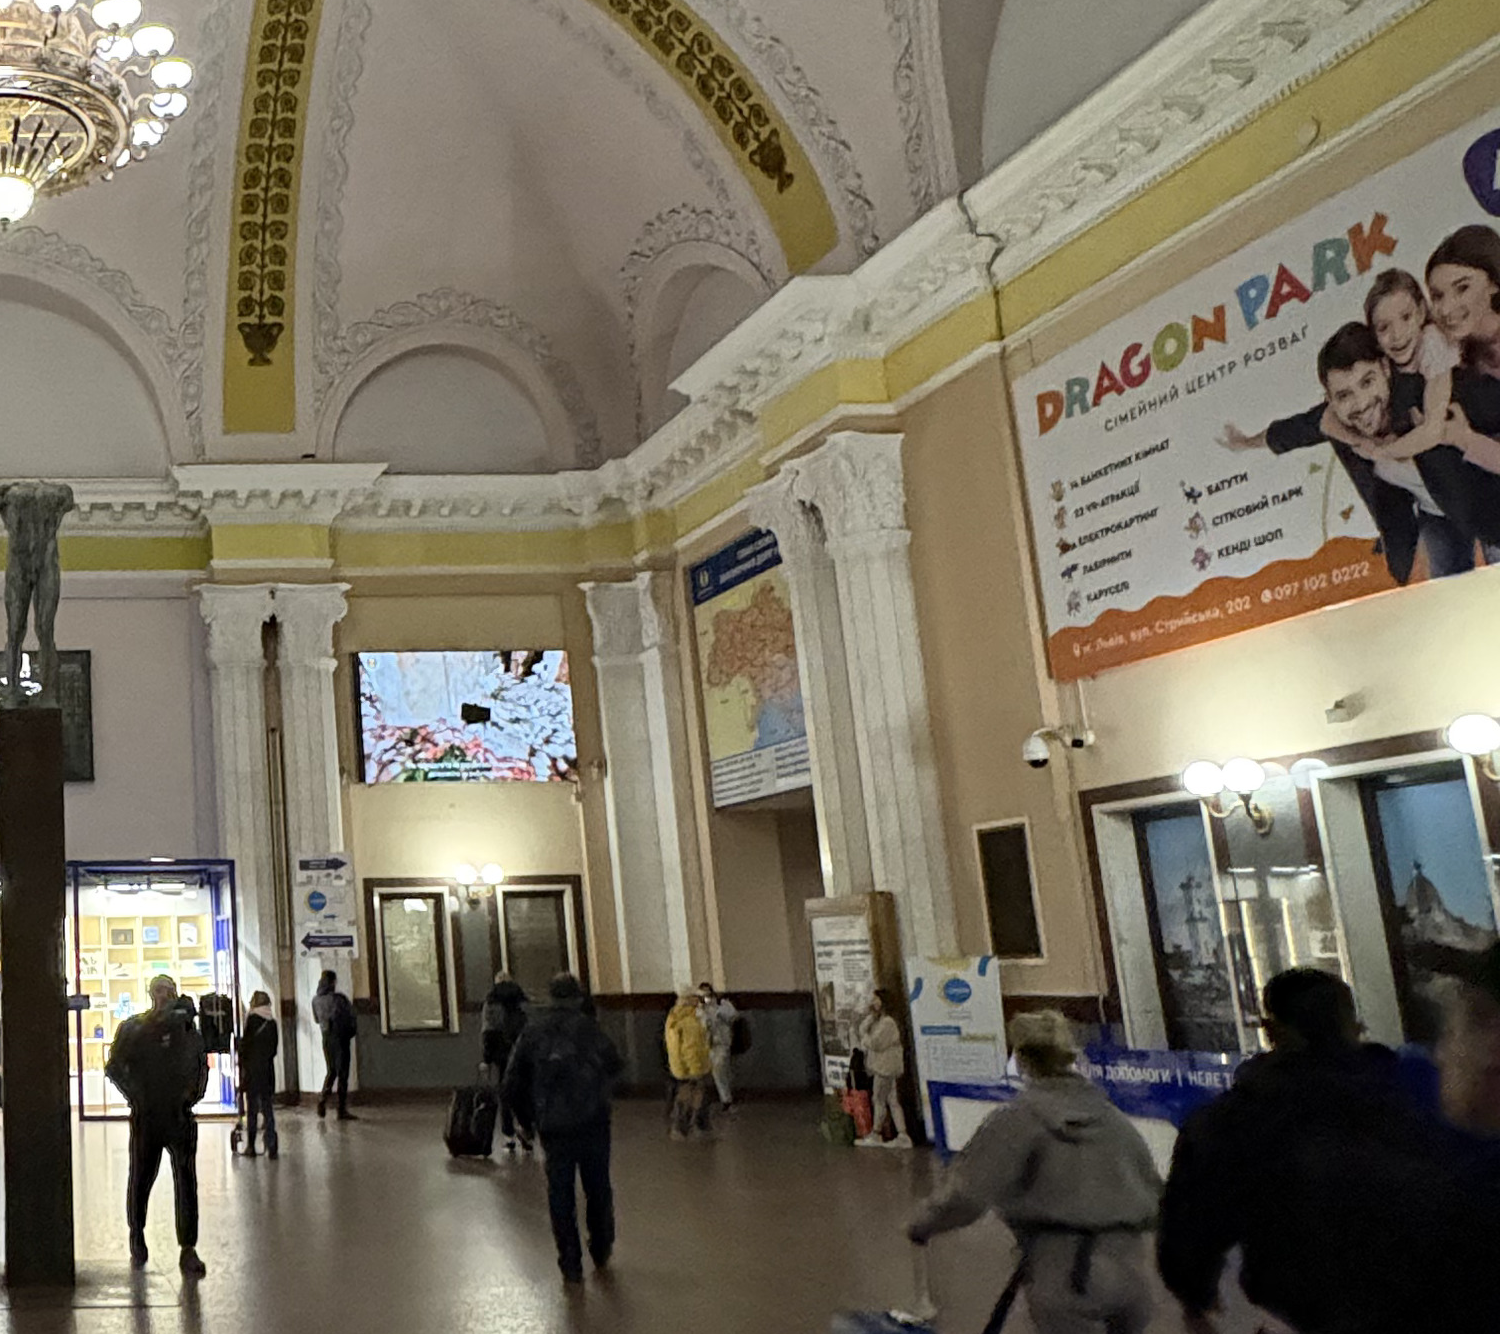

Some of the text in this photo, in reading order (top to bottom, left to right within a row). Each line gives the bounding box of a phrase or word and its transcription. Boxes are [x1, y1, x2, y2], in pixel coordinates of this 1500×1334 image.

[1036, 211, 1398, 437] DRAGON PARK
[1104, 324, 1308, 432] СІМЕЙНИЙ ЦЕНТР РОЗВАГ
[1207, 471, 1248, 496] БАТУТИ
[1211, 486, 1304, 527] СІТКОВИЙ ПАРК
[1217, 527, 1284, 559] КЕНДІ ШОП
[1225, 595, 1252, 615] 202
[1274, 581, 1300, 600] 097
[1303, 573, 1328, 591] 102
[1331, 561, 1370, 585] 0222
[1187, 1070, 1222, 1088] HERE
